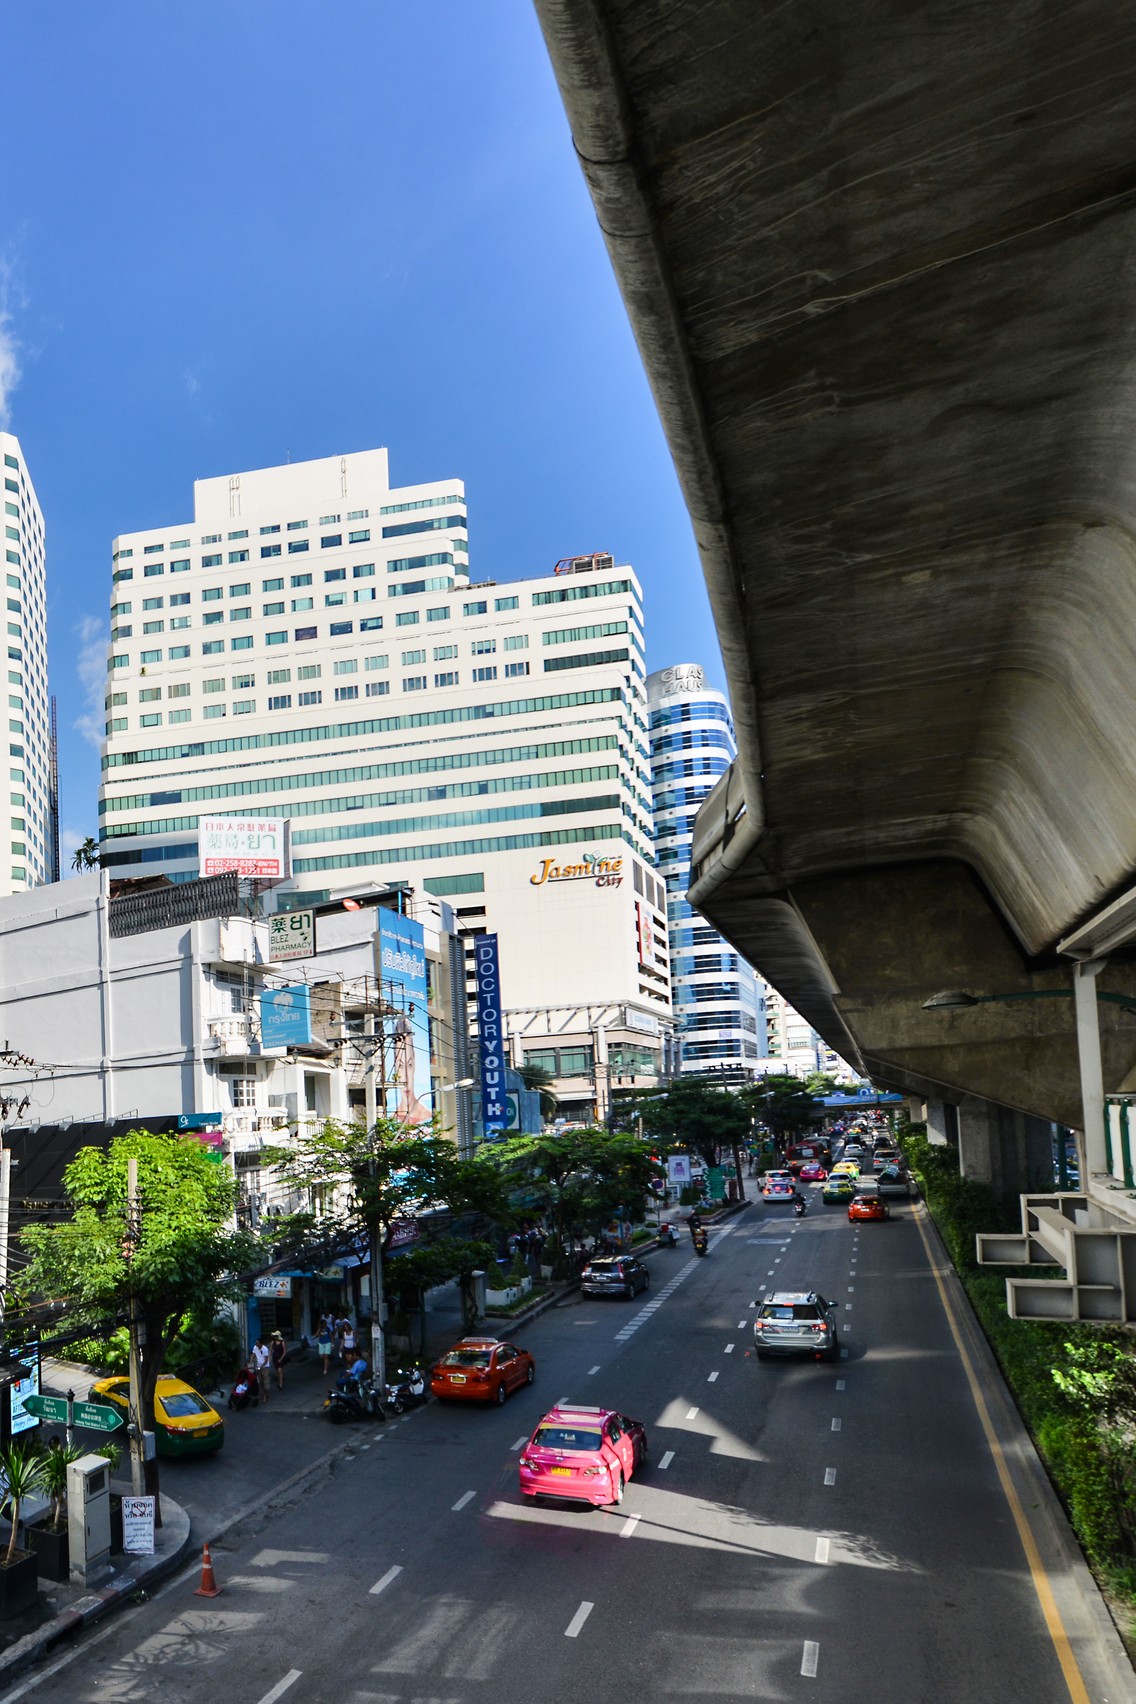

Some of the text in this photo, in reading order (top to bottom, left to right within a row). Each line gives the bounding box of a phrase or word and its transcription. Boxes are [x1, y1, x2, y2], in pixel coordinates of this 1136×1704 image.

[530, 857, 623, 885] Jasmine
[595, 875, 624, 889] City
[270, 934, 289, 944] BLEZ
[270, 941, 312, 952] PHARMACY
